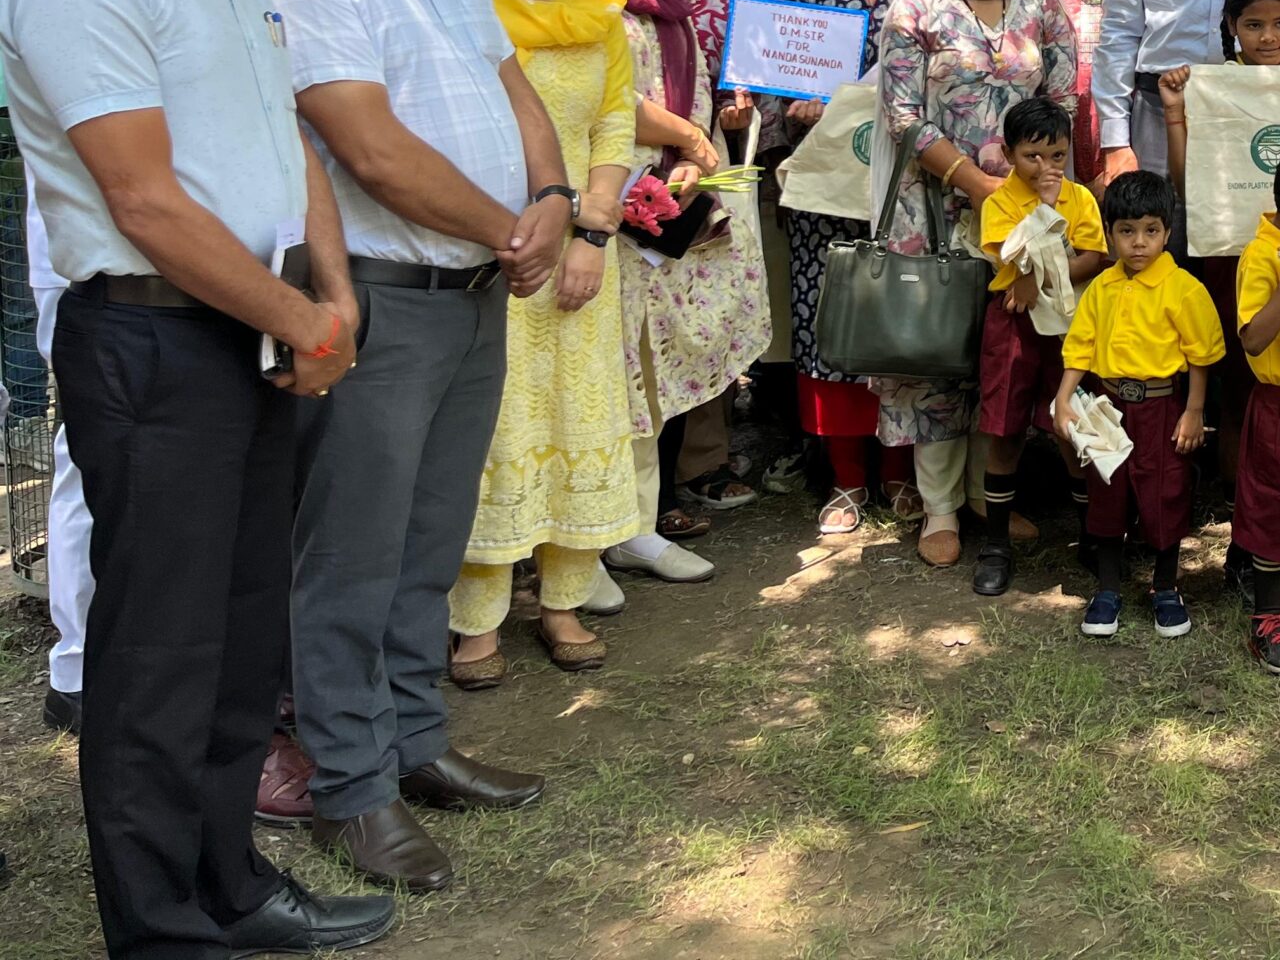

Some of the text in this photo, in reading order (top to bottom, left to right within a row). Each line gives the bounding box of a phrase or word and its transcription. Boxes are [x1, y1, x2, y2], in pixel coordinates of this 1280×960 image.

[771, 12, 829, 30] THANK YOU
[787, 41, 810, 52] FOR
[778, 65, 818, 79] YOJANA
[1227, 182, 1247, 190] ENDING
[1248, 181, 1269, 190] PLASTIC
